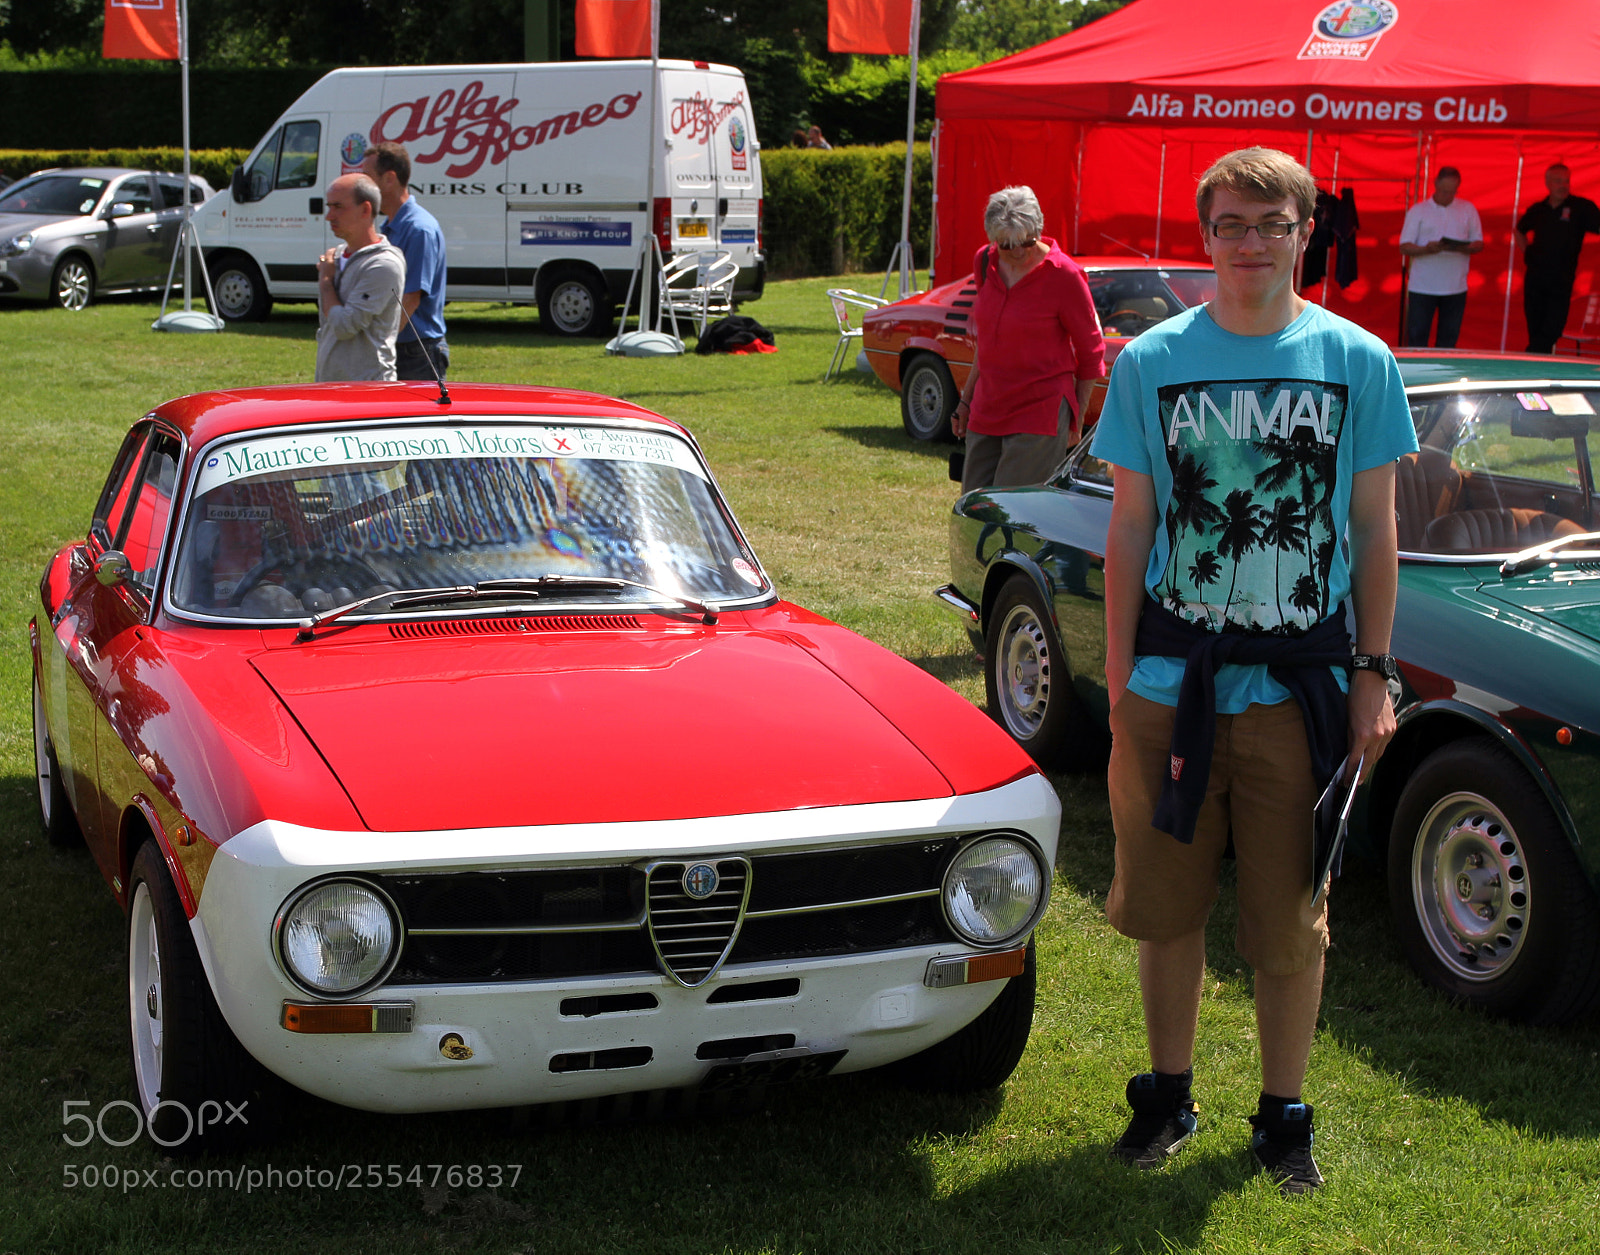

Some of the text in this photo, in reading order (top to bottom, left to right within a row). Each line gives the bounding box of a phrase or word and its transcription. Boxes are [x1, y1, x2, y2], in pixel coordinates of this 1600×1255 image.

[1307, 48, 1341, 56] CLUB
[1310, 42, 1368, 51] OWNERS
[1127, 93, 1507, 123] Alfa Romeo Owners Club
[724, 175, 750, 183] CLUB
[408, 182, 583, 195] NERS CLUB
[556, 230, 589, 238] KNOTT
[593, 230, 628, 238] GROUP
[1168, 389, 1336, 446] ANIMAL
[573, 427, 674, 450] Te Awamutu
[222, 430, 541, 478] Maurice Thomson Motors
[583, 443, 674, 462] 07 871 7311
[210, 509, 268, 518] GOODYEAR
